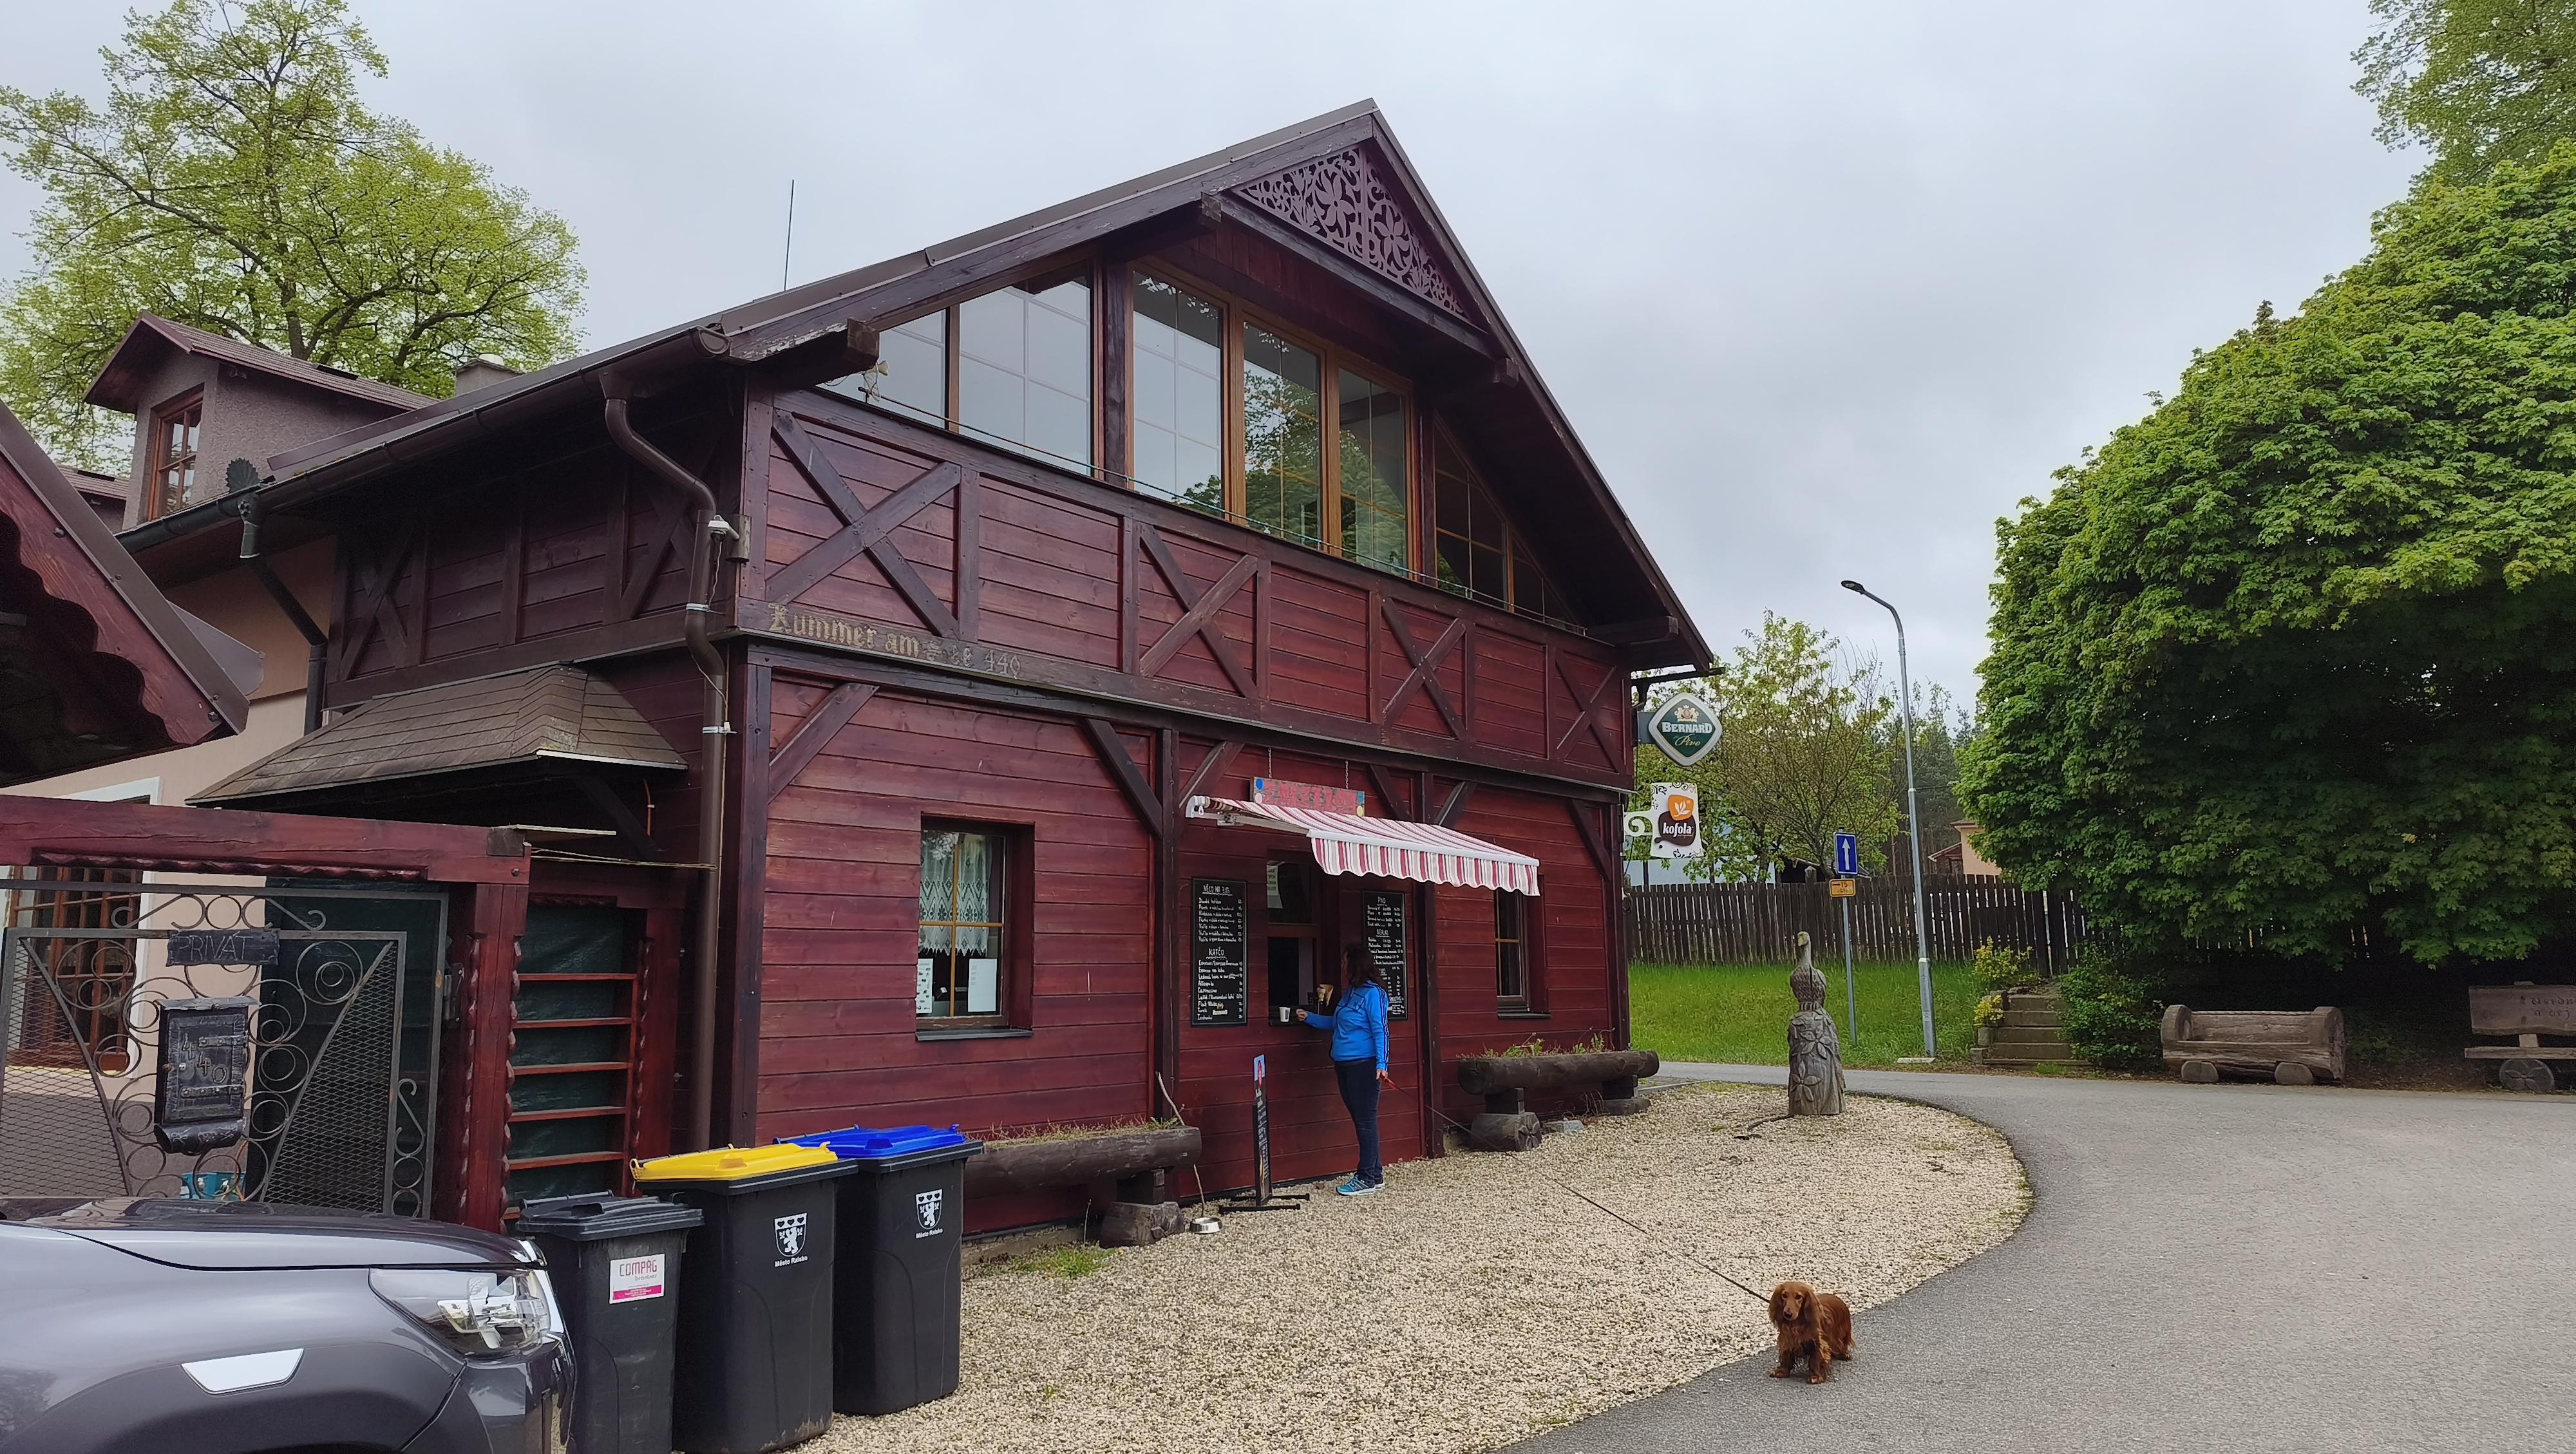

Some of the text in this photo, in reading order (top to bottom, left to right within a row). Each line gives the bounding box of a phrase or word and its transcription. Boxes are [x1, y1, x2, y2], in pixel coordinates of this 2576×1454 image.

[768, 603, 877, 649] Kummer
[885, 633, 919, 657] am
[984, 649, 1020, 679] 440
[1662, 722, 1712, 733] BERNARD
[1675, 733, 1701, 746] Pivo
[1662, 822, 1692, 837] kofola
[175, 931, 254, 961] PRIVÁT
[1209, 946, 1224, 956] KAFČO
